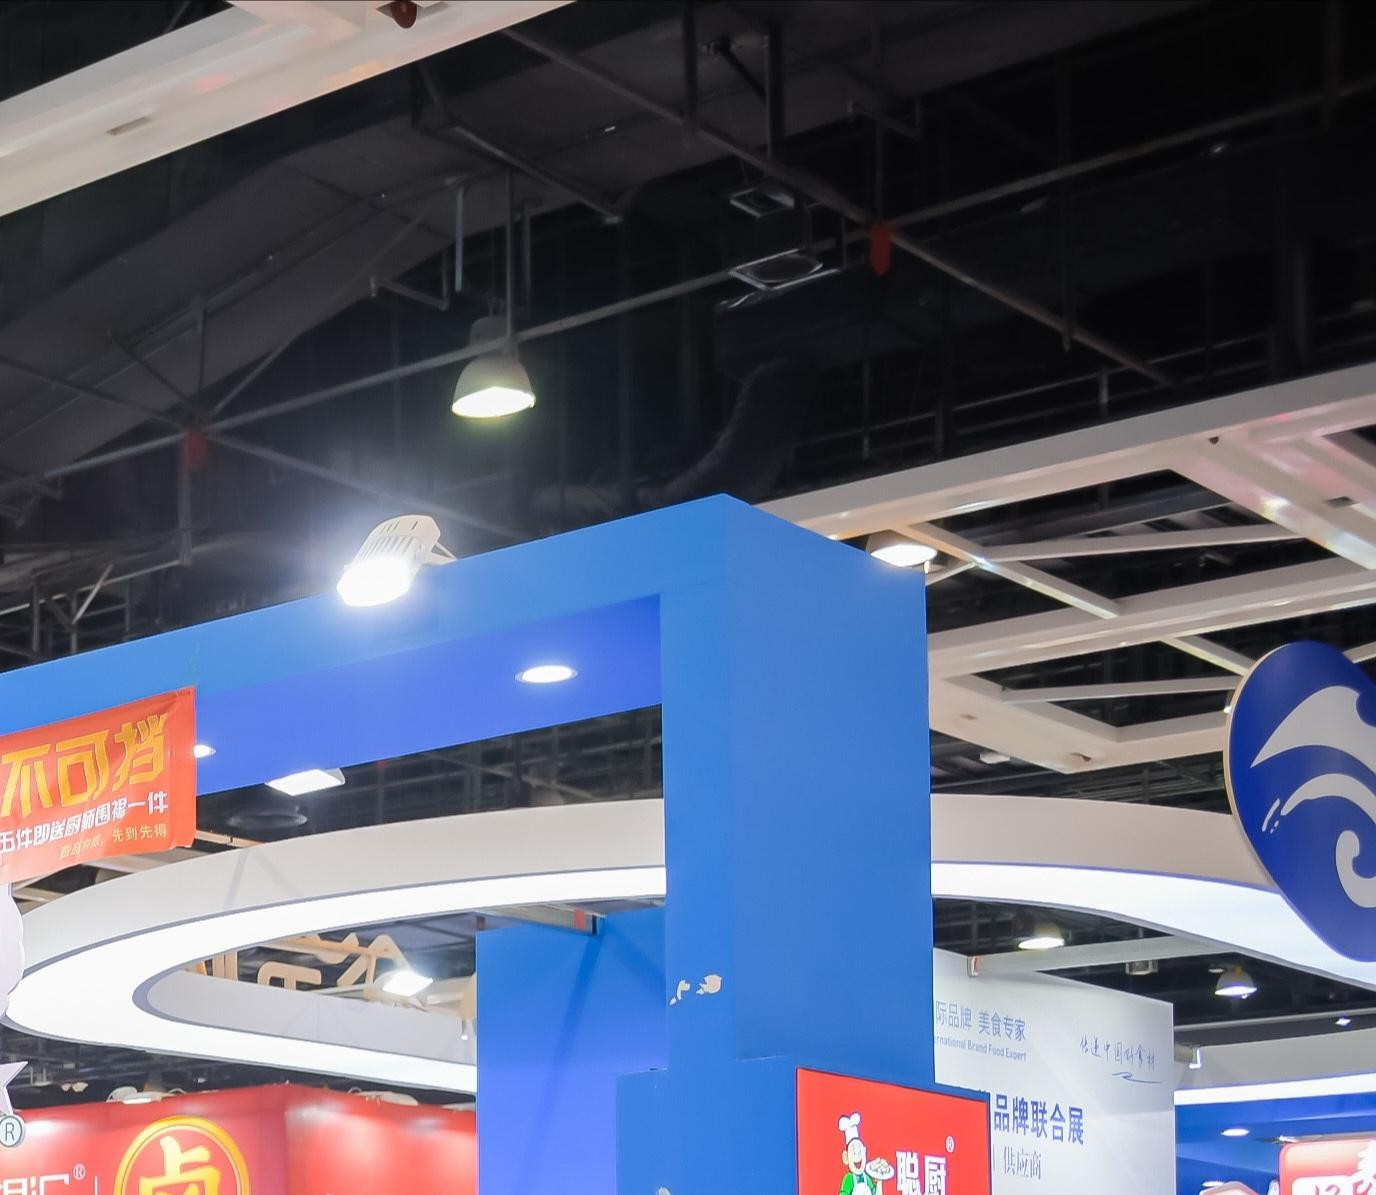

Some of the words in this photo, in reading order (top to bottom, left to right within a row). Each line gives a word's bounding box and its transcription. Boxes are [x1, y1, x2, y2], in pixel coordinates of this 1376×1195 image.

[978, 1010, 1026, 1042] 美食专家
[967, 1040, 987, 1054] Brand
[988, 1043, 1005, 1058] Food
[1005, 1047, 1027, 1062] Expert
[994, 1093, 1085, 1146] 品牌联合展
[1003, 1145, 1042, 1181] 供应商
